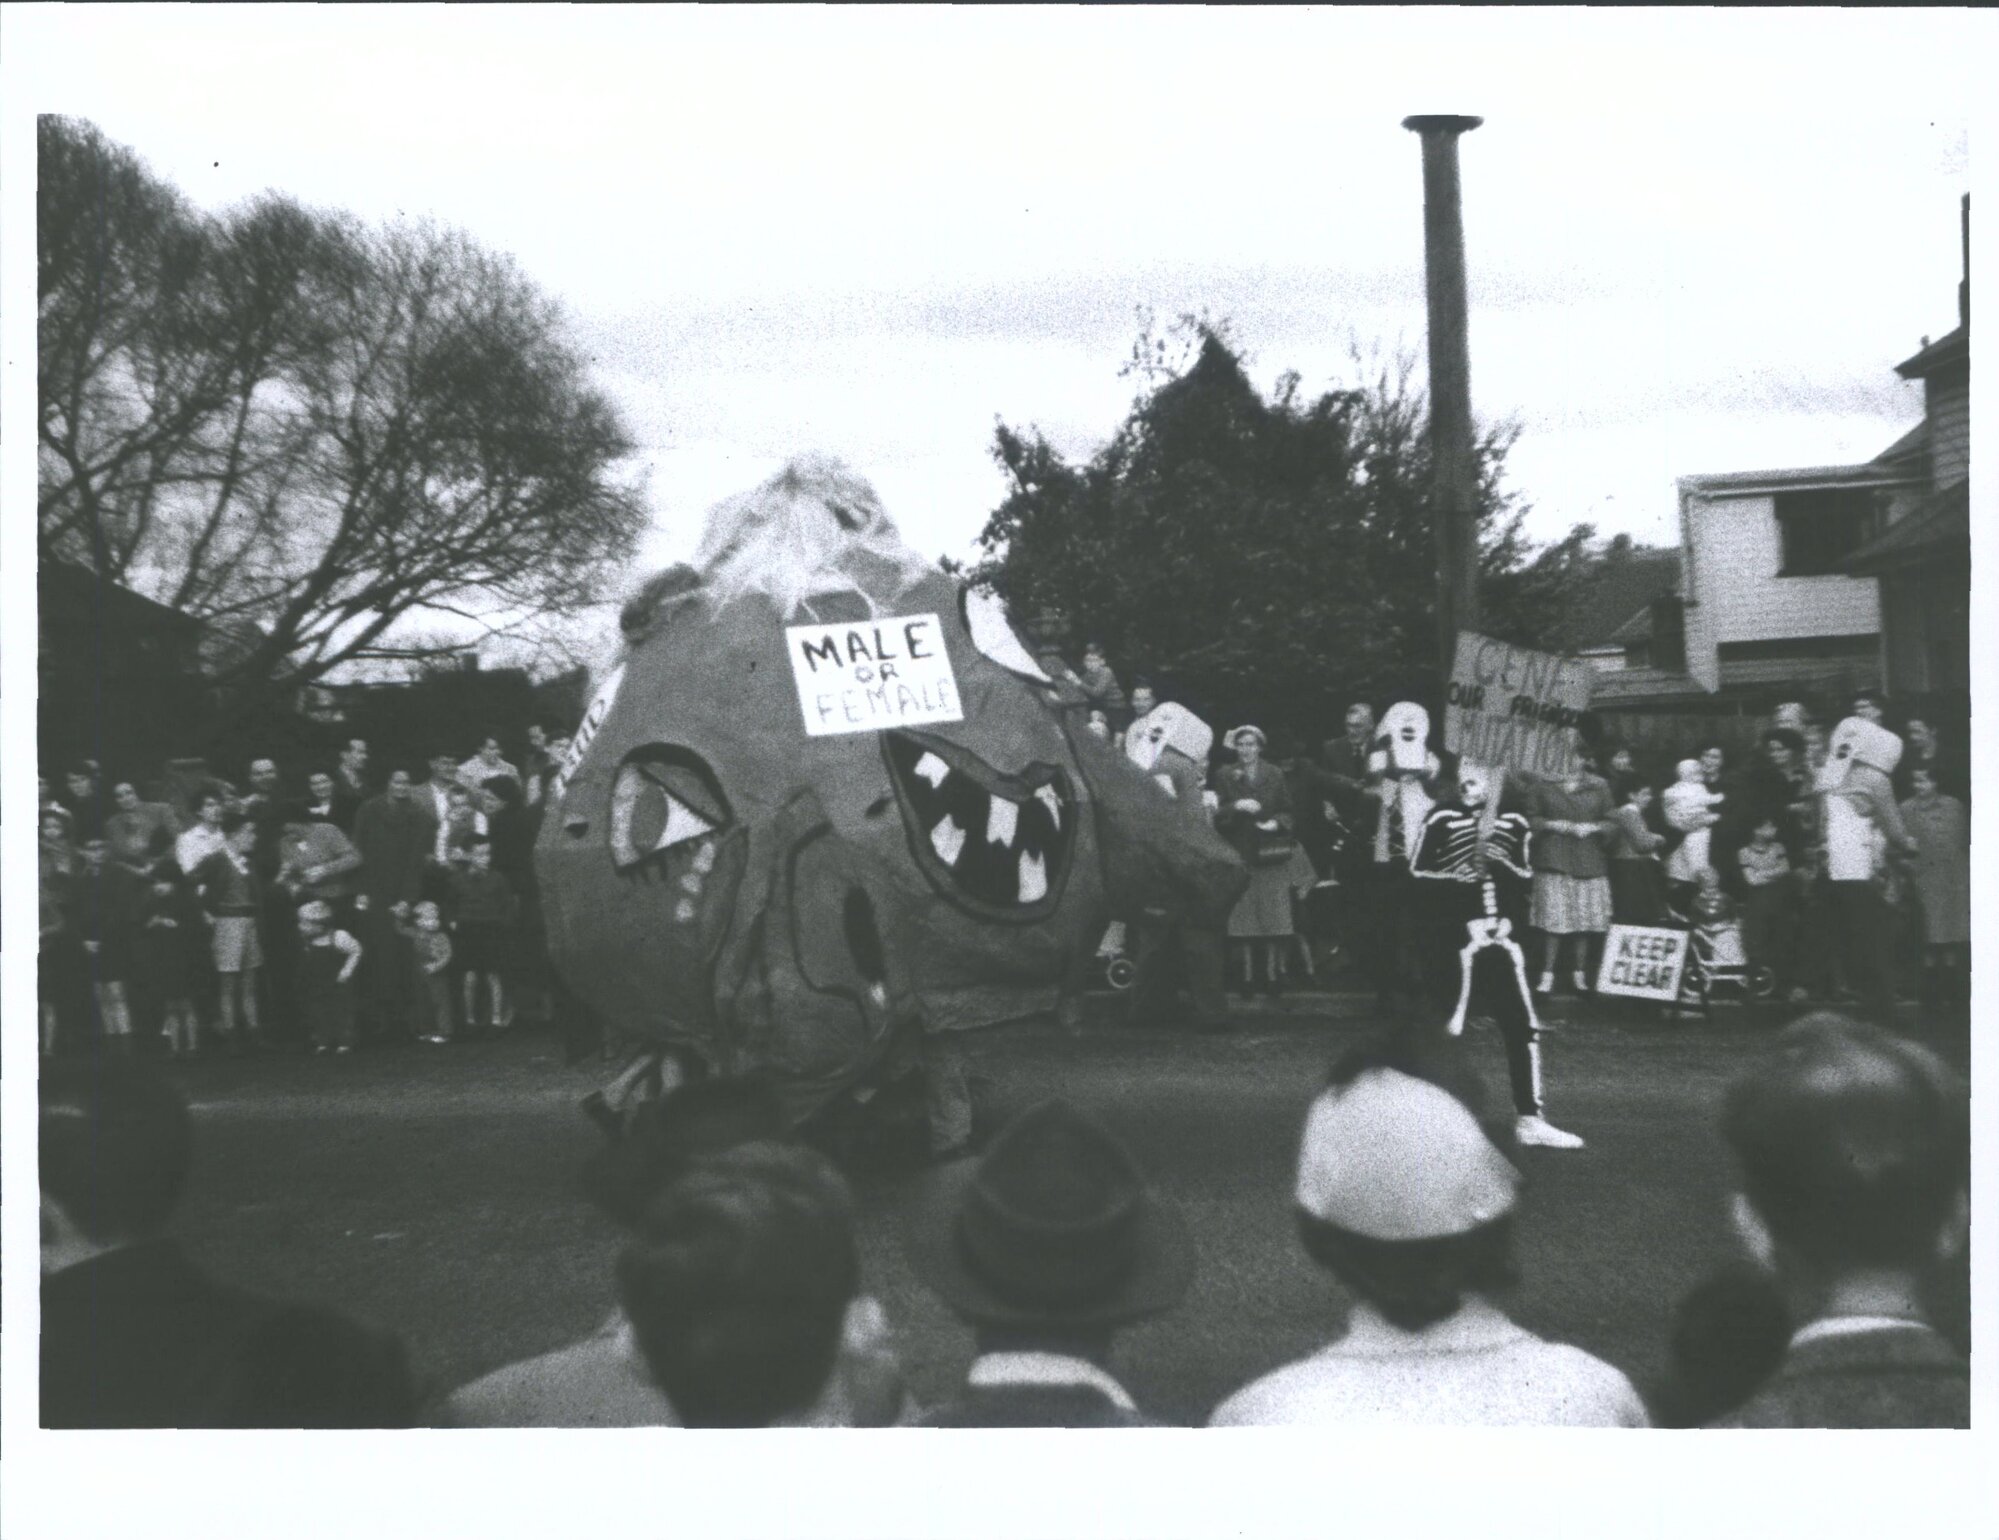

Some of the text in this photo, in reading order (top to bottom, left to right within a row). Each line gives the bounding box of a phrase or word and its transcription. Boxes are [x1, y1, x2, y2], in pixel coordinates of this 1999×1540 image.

[801, 621, 934, 673] MALE
[855, 662, 899, 682] OR
[816, 678, 956, 723] FEMALE
[1448, 682, 1485, 710] OUR
[1619, 934, 1677, 960] KEEP
[1610, 961, 1674, 990] CLEAR
